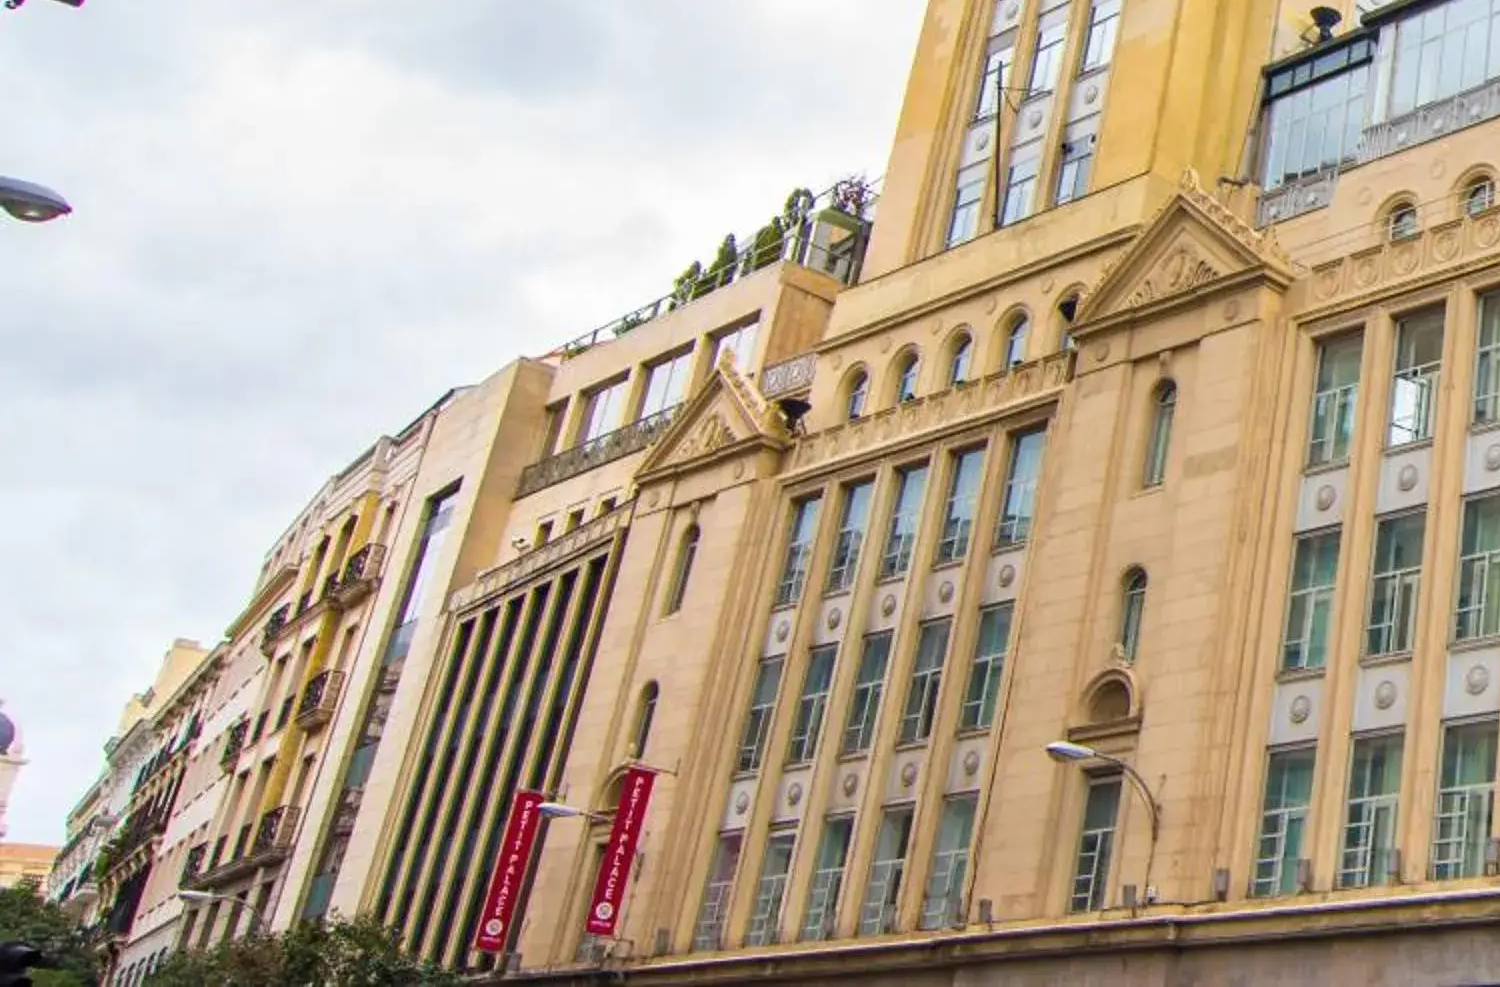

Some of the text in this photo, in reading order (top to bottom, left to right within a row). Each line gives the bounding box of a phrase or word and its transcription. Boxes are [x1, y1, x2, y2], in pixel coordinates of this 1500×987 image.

[495, 800, 533, 916] PETIT PALACE
[605, 776, 644, 900] PETIT PALACE
